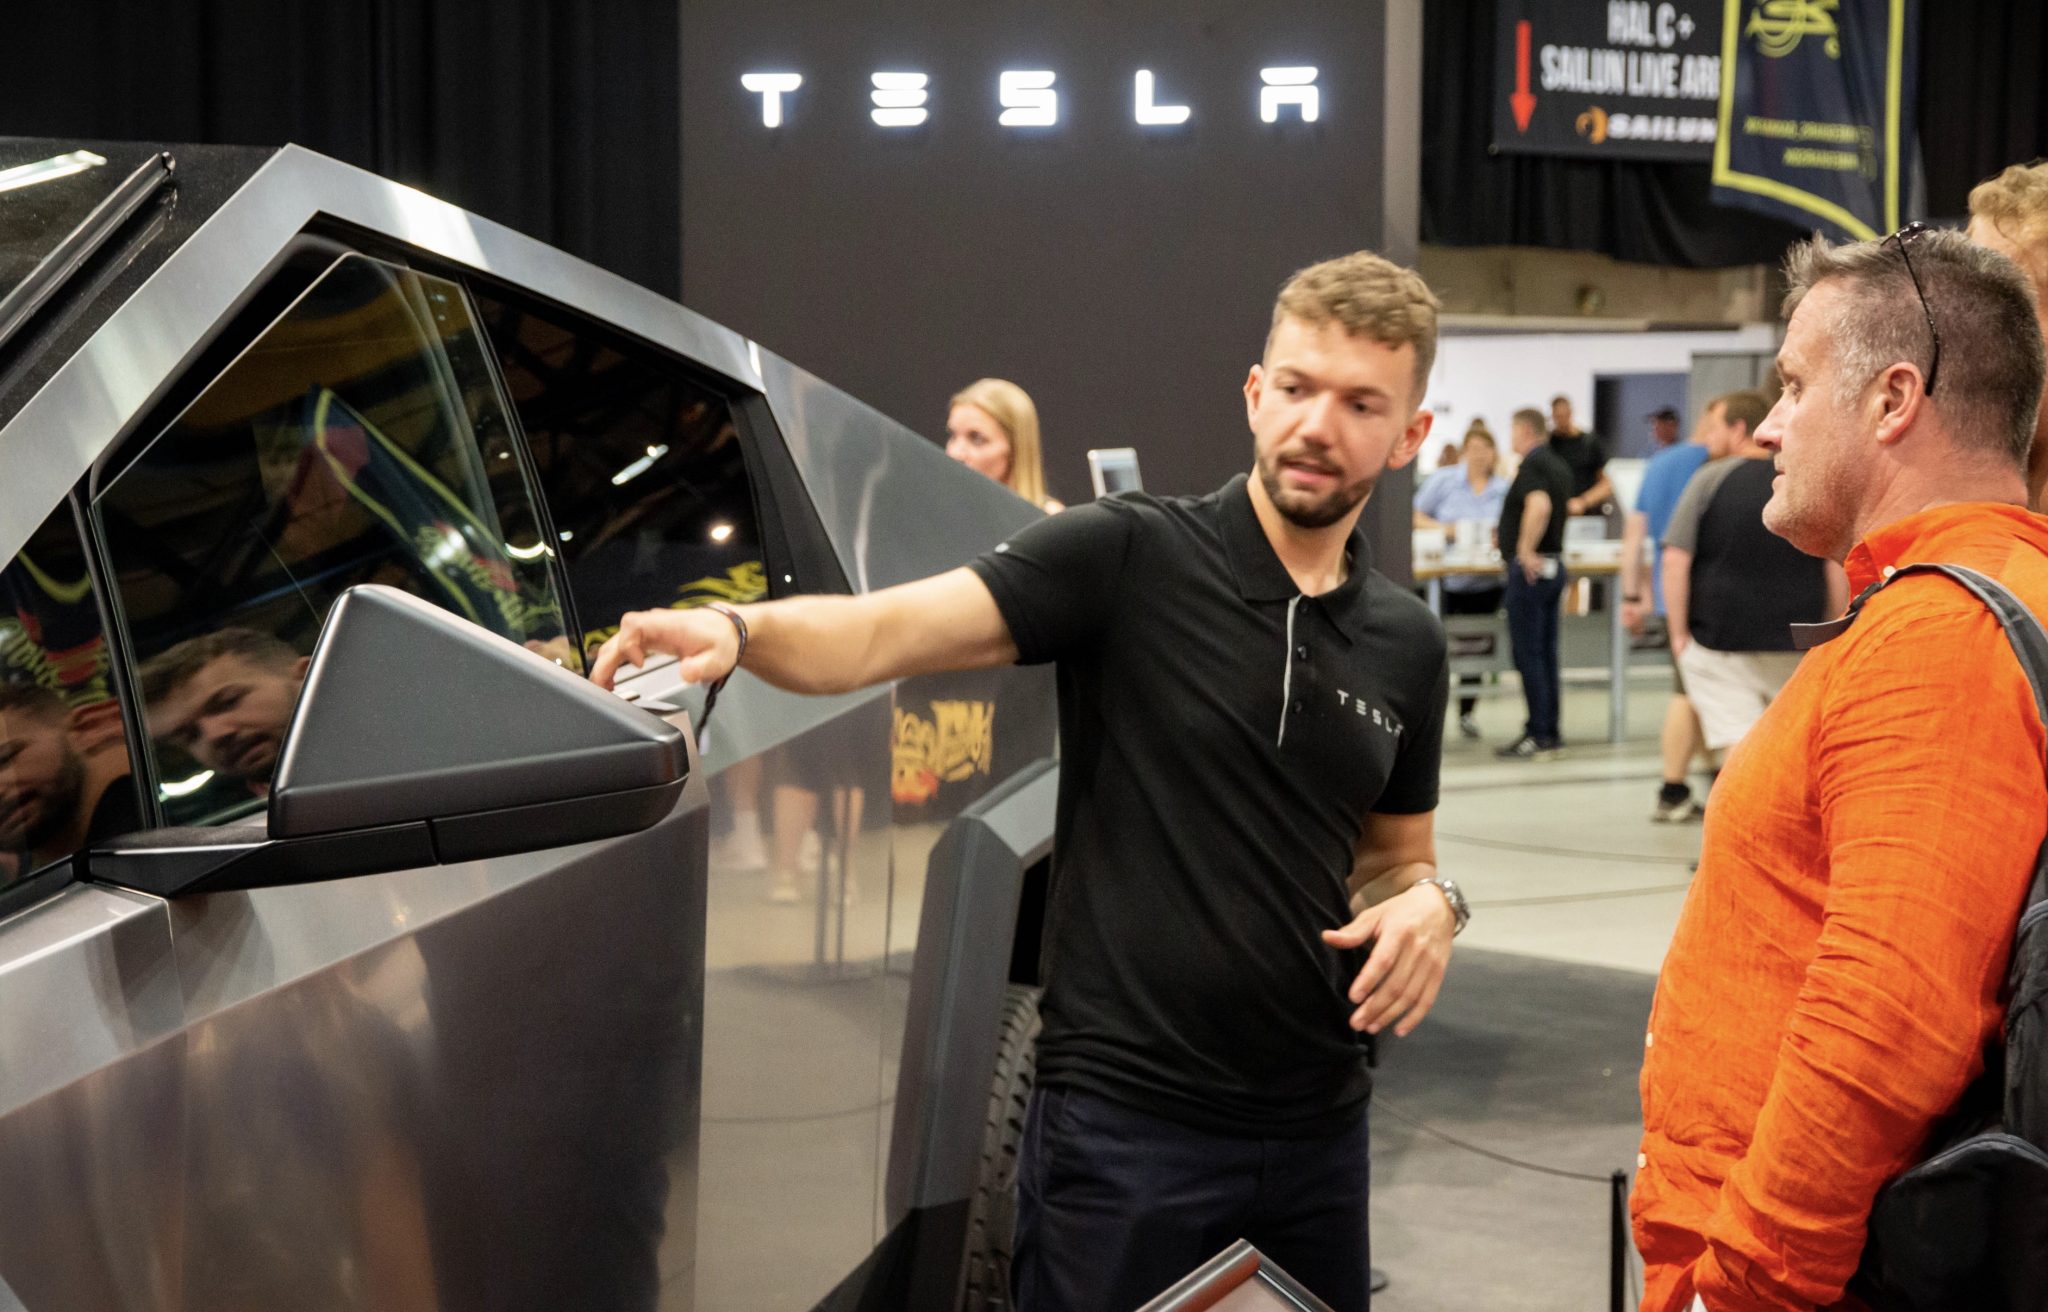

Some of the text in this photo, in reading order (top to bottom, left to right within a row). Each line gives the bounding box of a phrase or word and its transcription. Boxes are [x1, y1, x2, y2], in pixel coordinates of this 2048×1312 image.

[741, 66, 1319, 129] TESLA
[1540, 44, 1626, 95] SAILUN
[1627, 50, 1680, 98] LIVE
